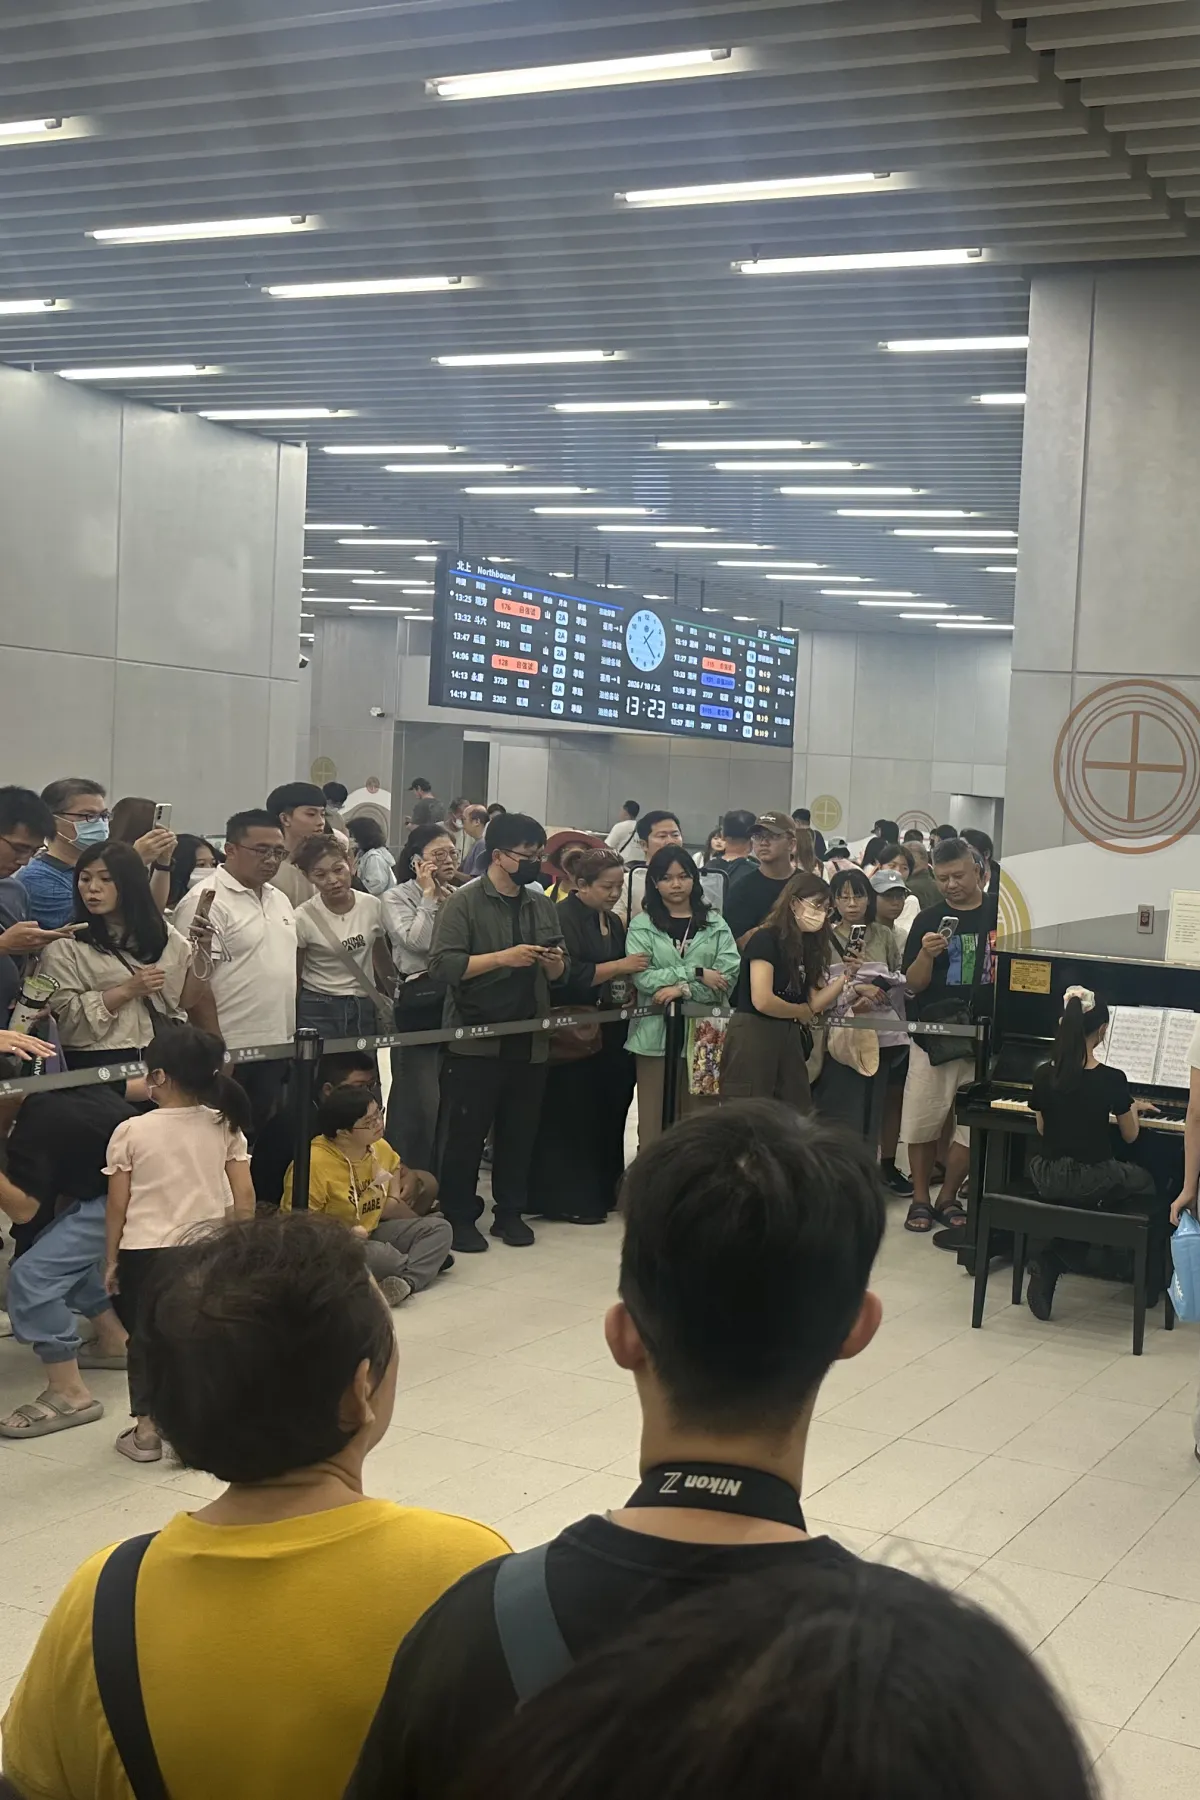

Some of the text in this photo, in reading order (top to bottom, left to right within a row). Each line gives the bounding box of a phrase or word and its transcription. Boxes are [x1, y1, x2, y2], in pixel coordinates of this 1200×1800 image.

[457, 561, 516, 582] 北上 Northbound
[455, 594, 472, 603] 13:25
[454, 613, 472, 623] 13:32
[474, 615, 487, 626] 斗六
[453, 632, 470, 642] 13:47
[452, 651, 469, 661] 14:06
[451, 671, 469, 680] 14:13
[450, 690, 468, 699] 14:19
[626, 696, 666, 719] 13:23
[342, 934, 364, 948] OUND
[348, 940, 366, 951] AVES
[362, 1198, 381, 1215] BABE
[659, 1472, 742, 1497] Nikon Z
